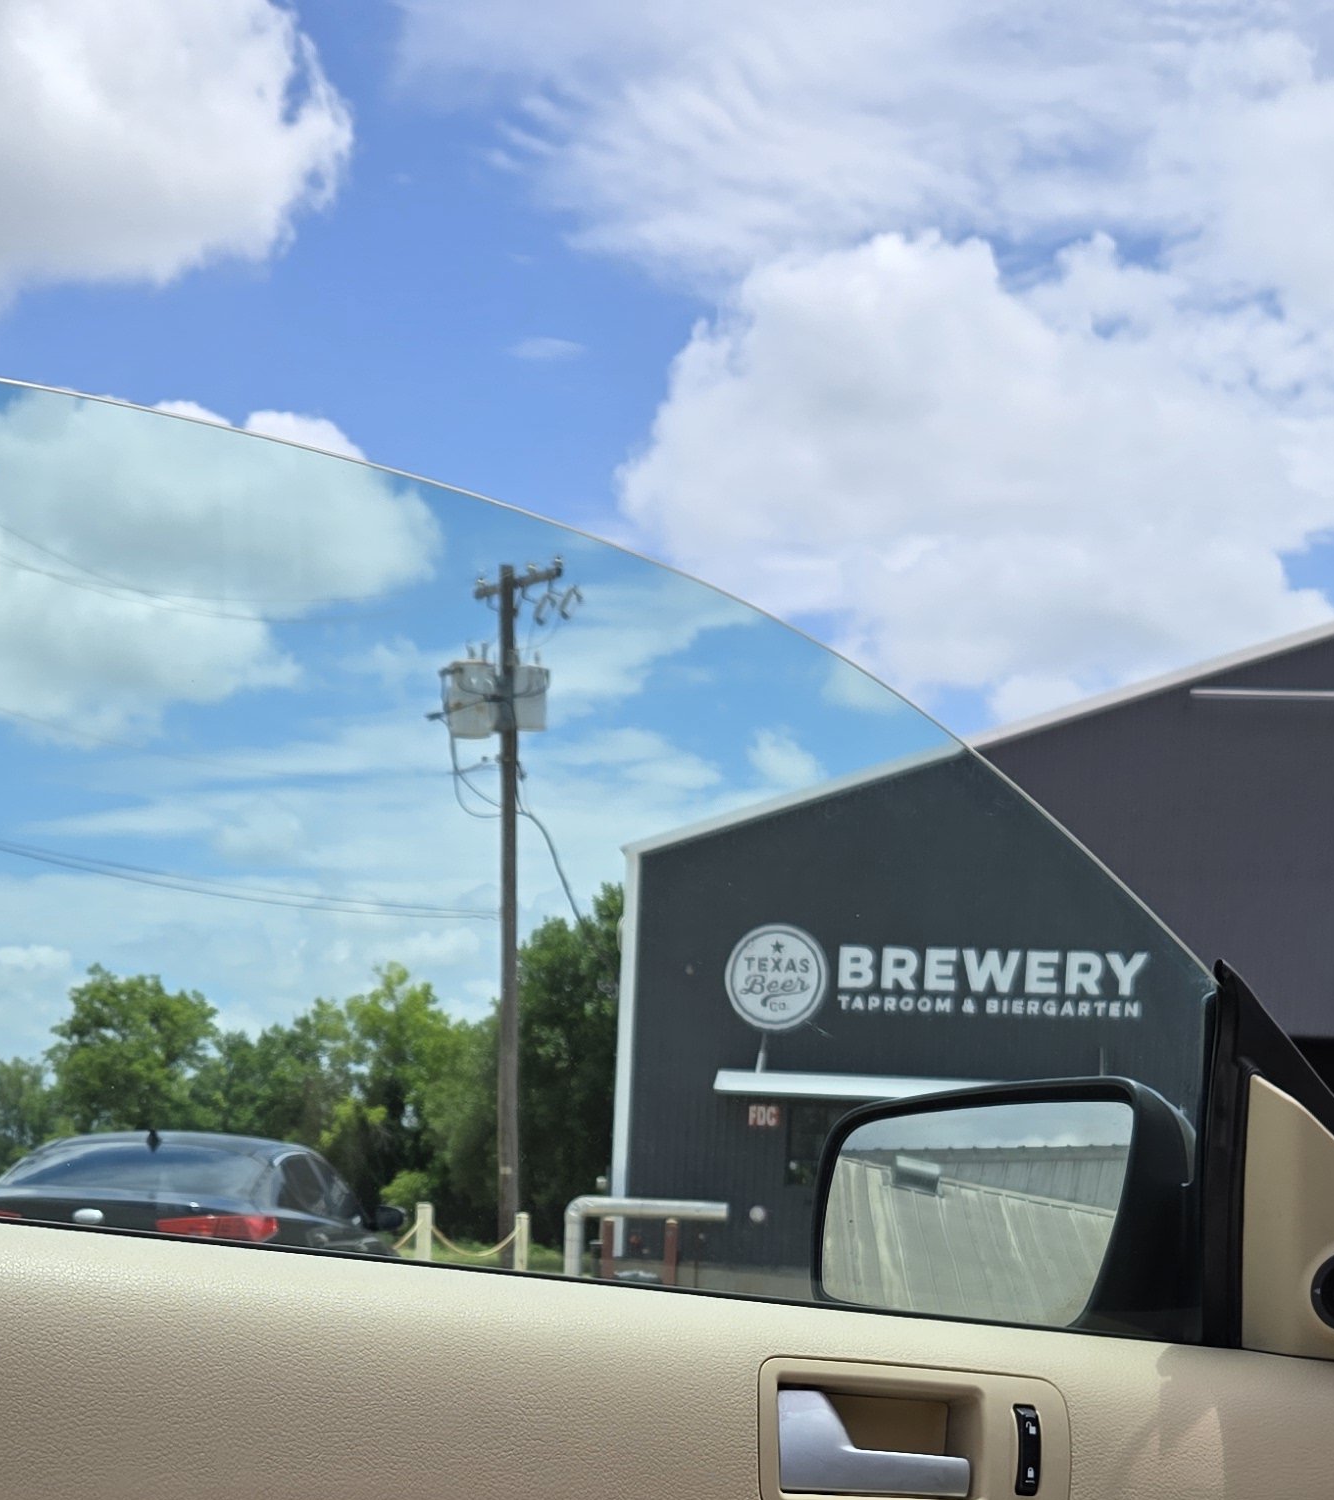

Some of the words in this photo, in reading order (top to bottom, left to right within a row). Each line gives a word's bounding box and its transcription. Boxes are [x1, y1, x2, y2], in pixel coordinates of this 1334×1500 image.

[744, 957, 811, 974] TEXAS
[837, 944, 1149, 997] BREWERY
[740, 974, 811, 1007] Beer
[838, 994, 951, 1014] TAPROOM
[961, 998, 976, 1014] &
[985, 998, 1142, 1018] BIERGARTEN
[748, 1105, 778, 1127] FDC
